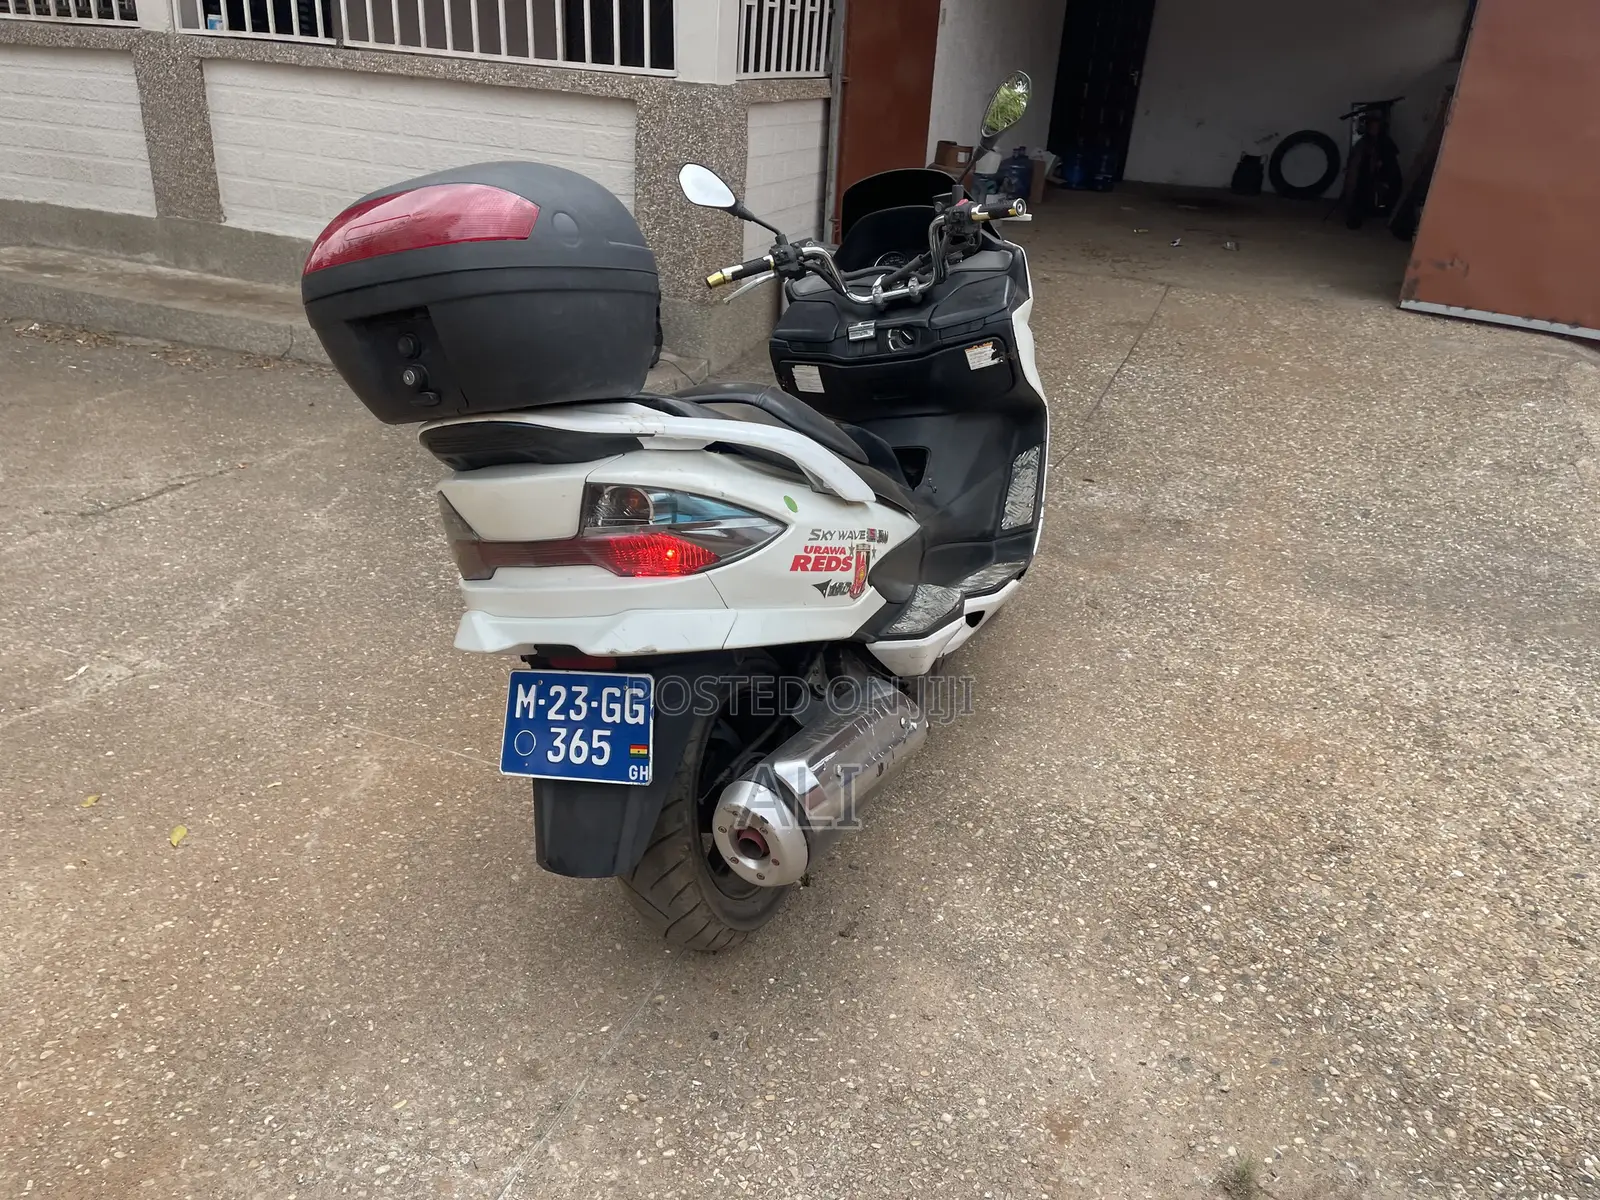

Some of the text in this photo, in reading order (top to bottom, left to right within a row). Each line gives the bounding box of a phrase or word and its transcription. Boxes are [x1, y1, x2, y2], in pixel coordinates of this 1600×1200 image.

[804, 545, 847, 555] URAWA
[789, 554, 854, 573] REDS
[546, 727, 612, 766] 365
[628, 764, 649, 781] GH
